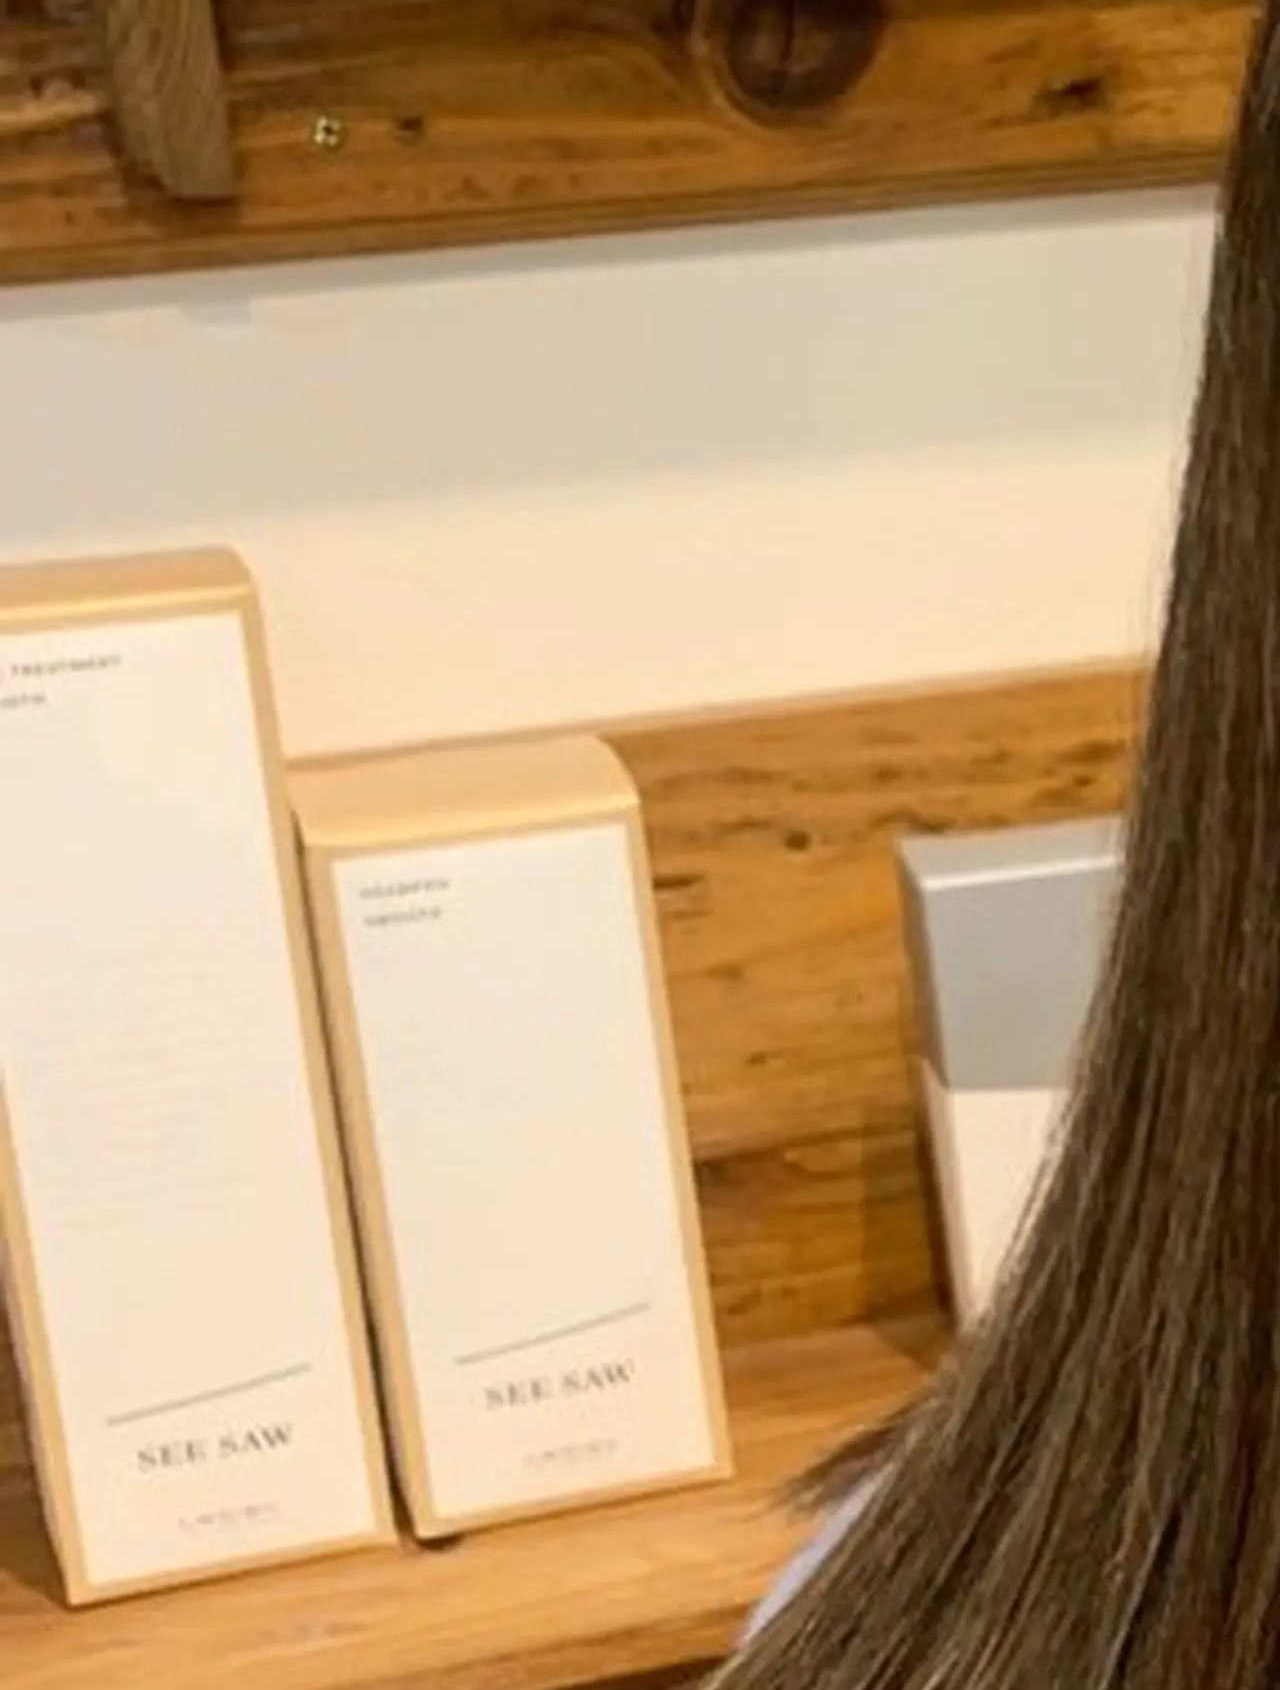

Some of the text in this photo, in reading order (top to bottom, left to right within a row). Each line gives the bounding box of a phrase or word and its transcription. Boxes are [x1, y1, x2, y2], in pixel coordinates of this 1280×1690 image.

[485, 1358, 634, 1410] SEE SAW
[137, 1422, 293, 1474] SEE SAW
